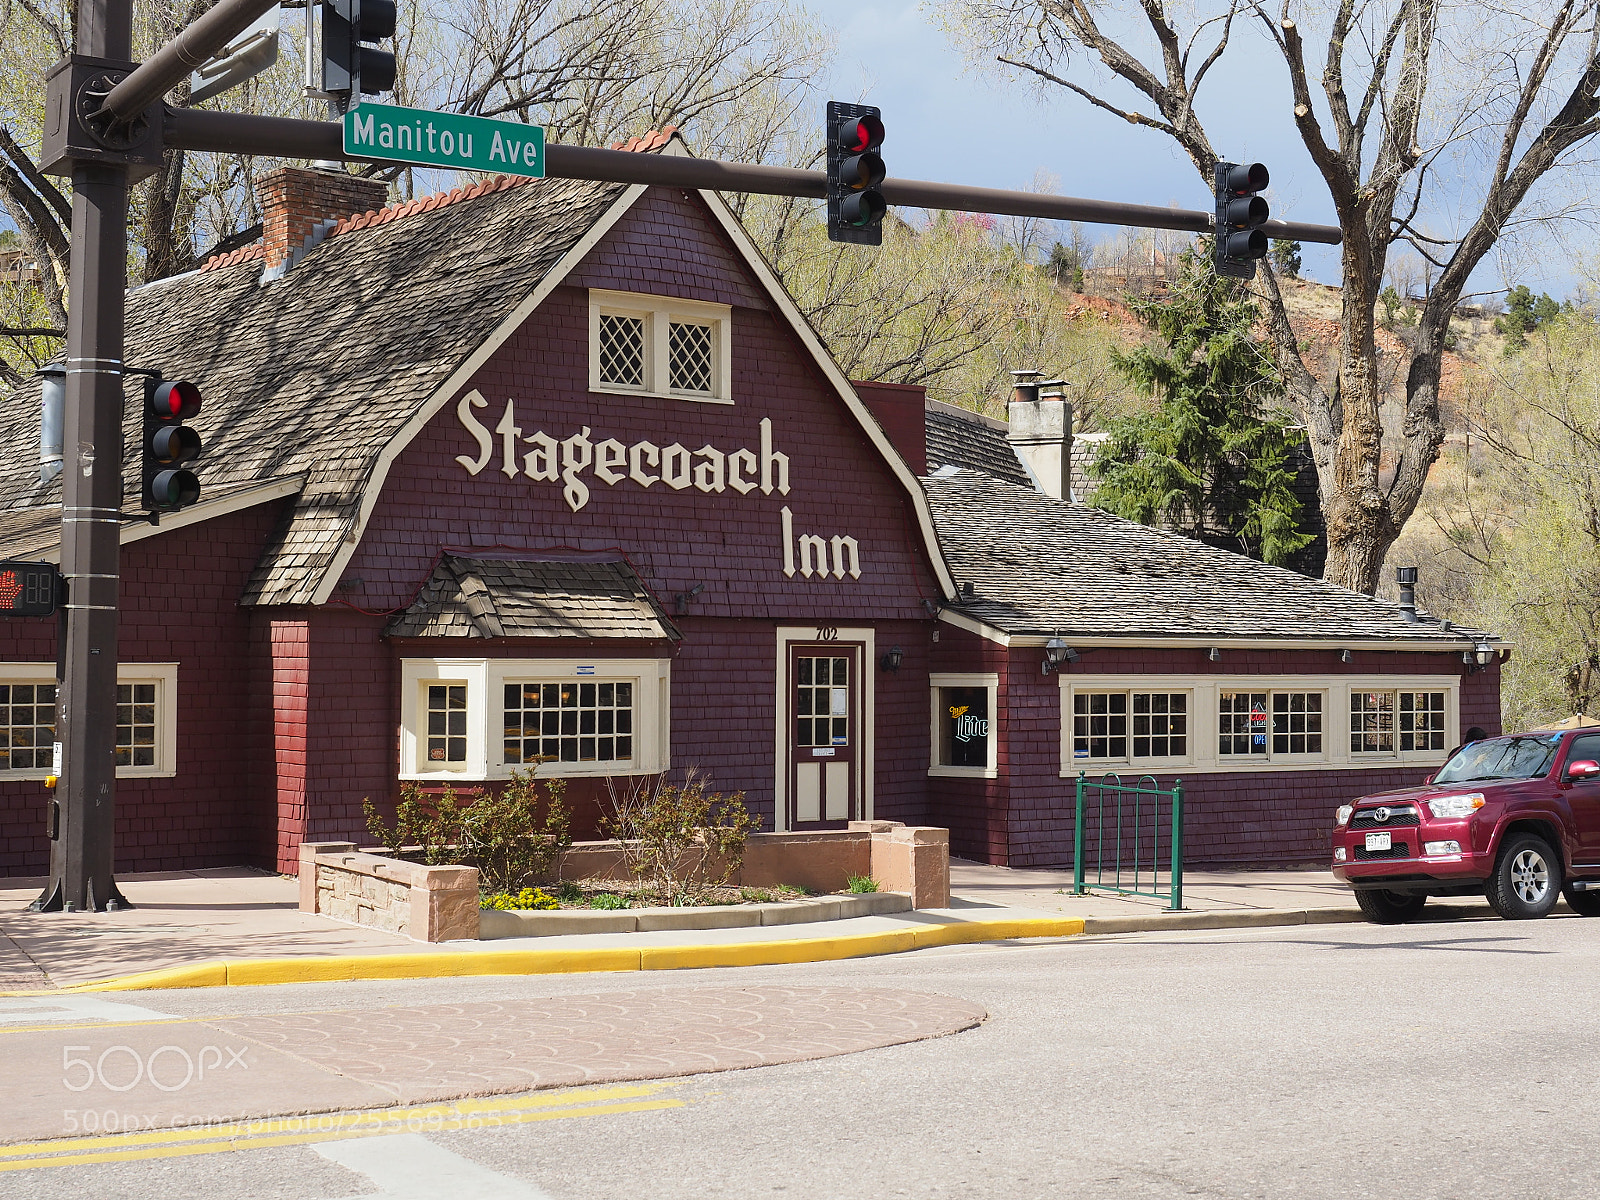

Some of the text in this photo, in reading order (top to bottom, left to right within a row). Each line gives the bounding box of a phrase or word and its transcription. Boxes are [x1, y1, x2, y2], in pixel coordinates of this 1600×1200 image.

[353, 112, 537, 167] Manitou Ave
[455, 388, 791, 513] Stagecoach
[780, 505, 862, 581] Inn
[816, 626, 838, 641] 702
[956, 714, 988, 742] Lite
